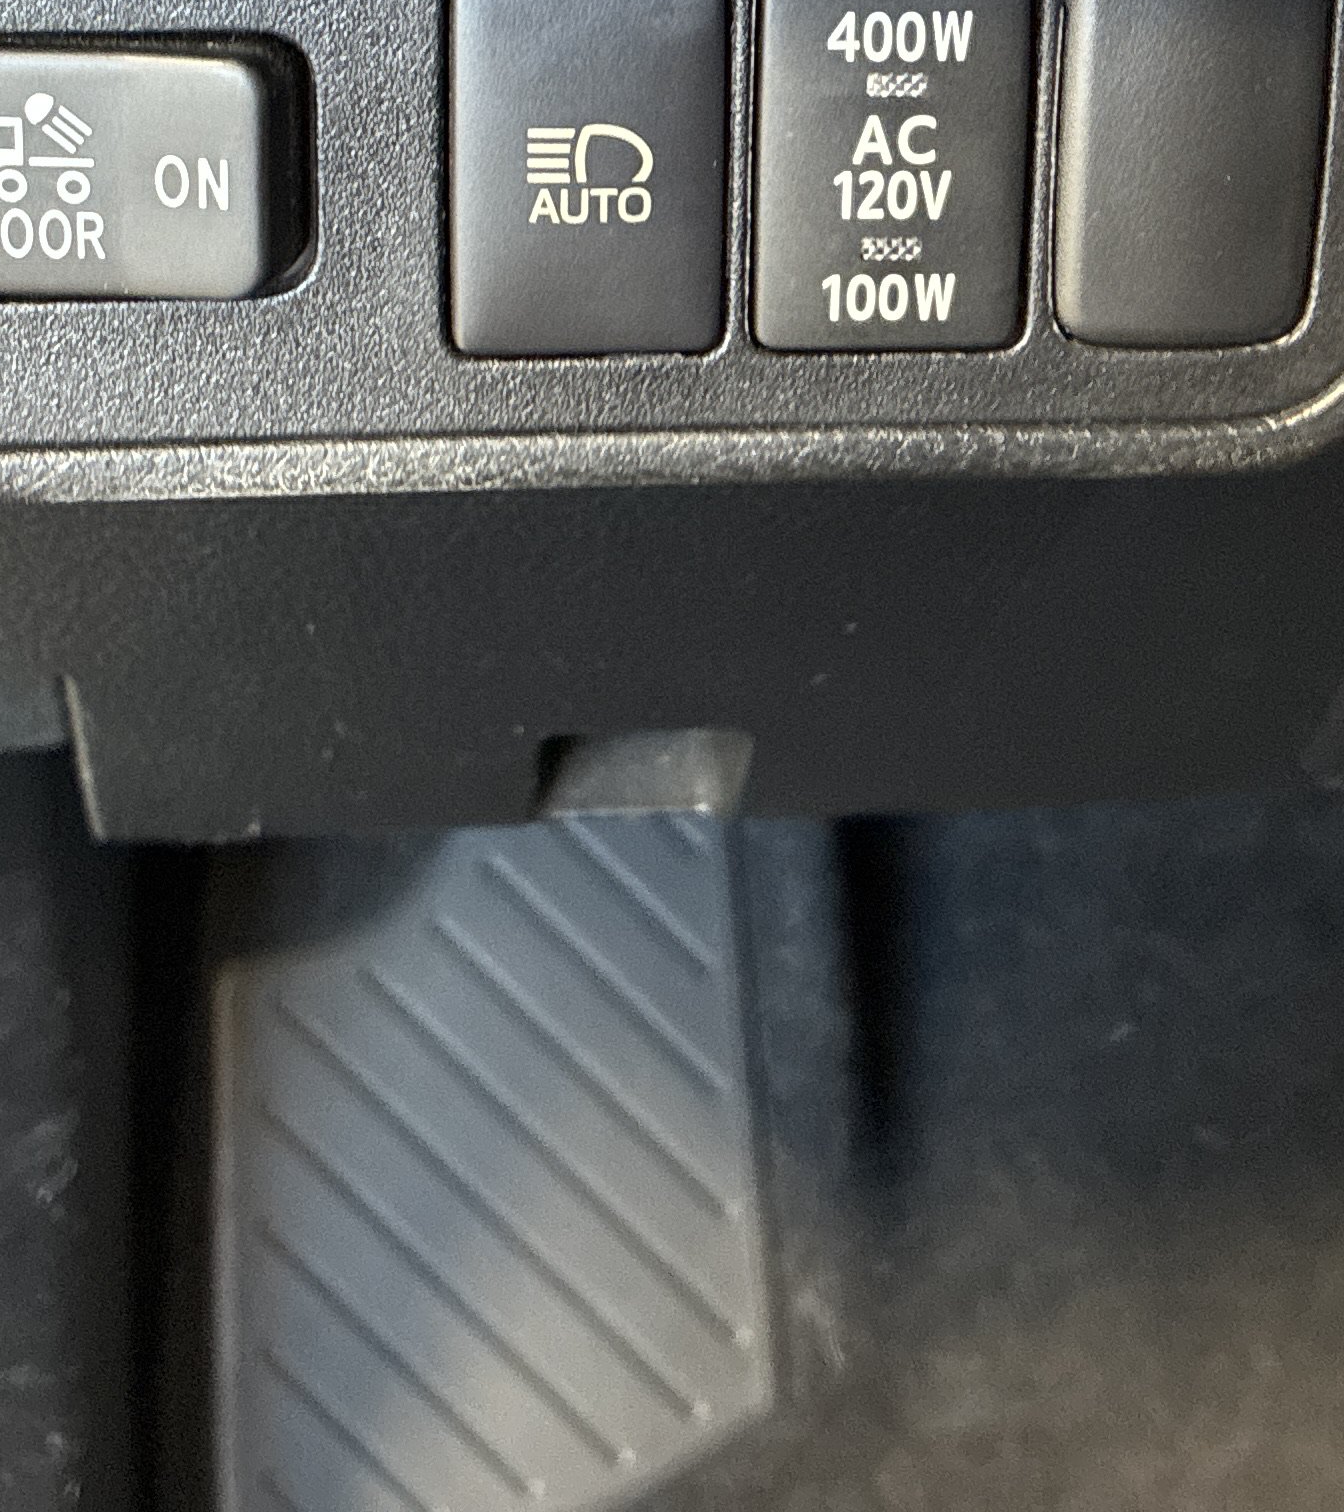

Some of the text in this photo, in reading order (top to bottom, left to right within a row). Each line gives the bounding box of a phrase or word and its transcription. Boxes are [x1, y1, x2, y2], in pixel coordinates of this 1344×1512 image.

[826, 10, 973, 64] 400W
[851, 114, 938, 166] AC
[154, 154, 230, 211] ON
[528, 187, 652, 225] AUTO
[832, 169, 953, 221] 120V
[820, 272, 956, 322] 100W
